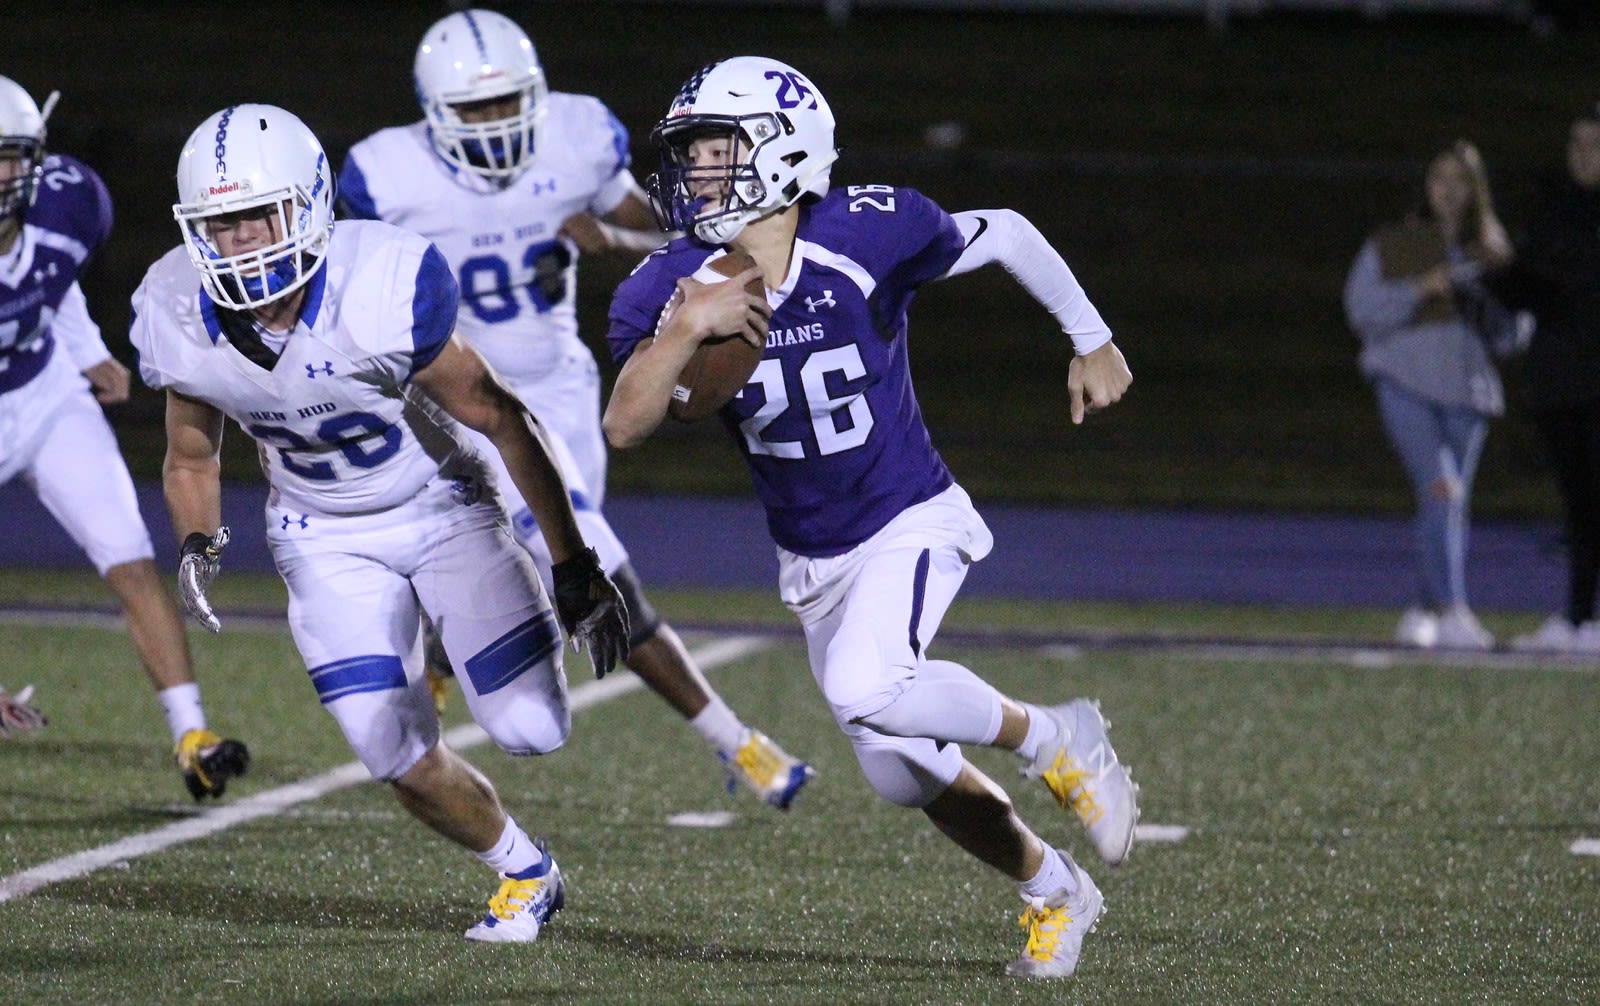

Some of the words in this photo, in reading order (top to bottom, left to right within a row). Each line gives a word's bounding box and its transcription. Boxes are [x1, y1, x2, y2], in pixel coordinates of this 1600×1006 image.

[208, 182, 239, 196] Riddell
[847, 183, 896, 213] 26
[765, 322, 825, 348] DIANS
[250, 411, 287, 422] HEN
[297, 402, 337, 419] HUD
[735, 343, 875, 460] 26
